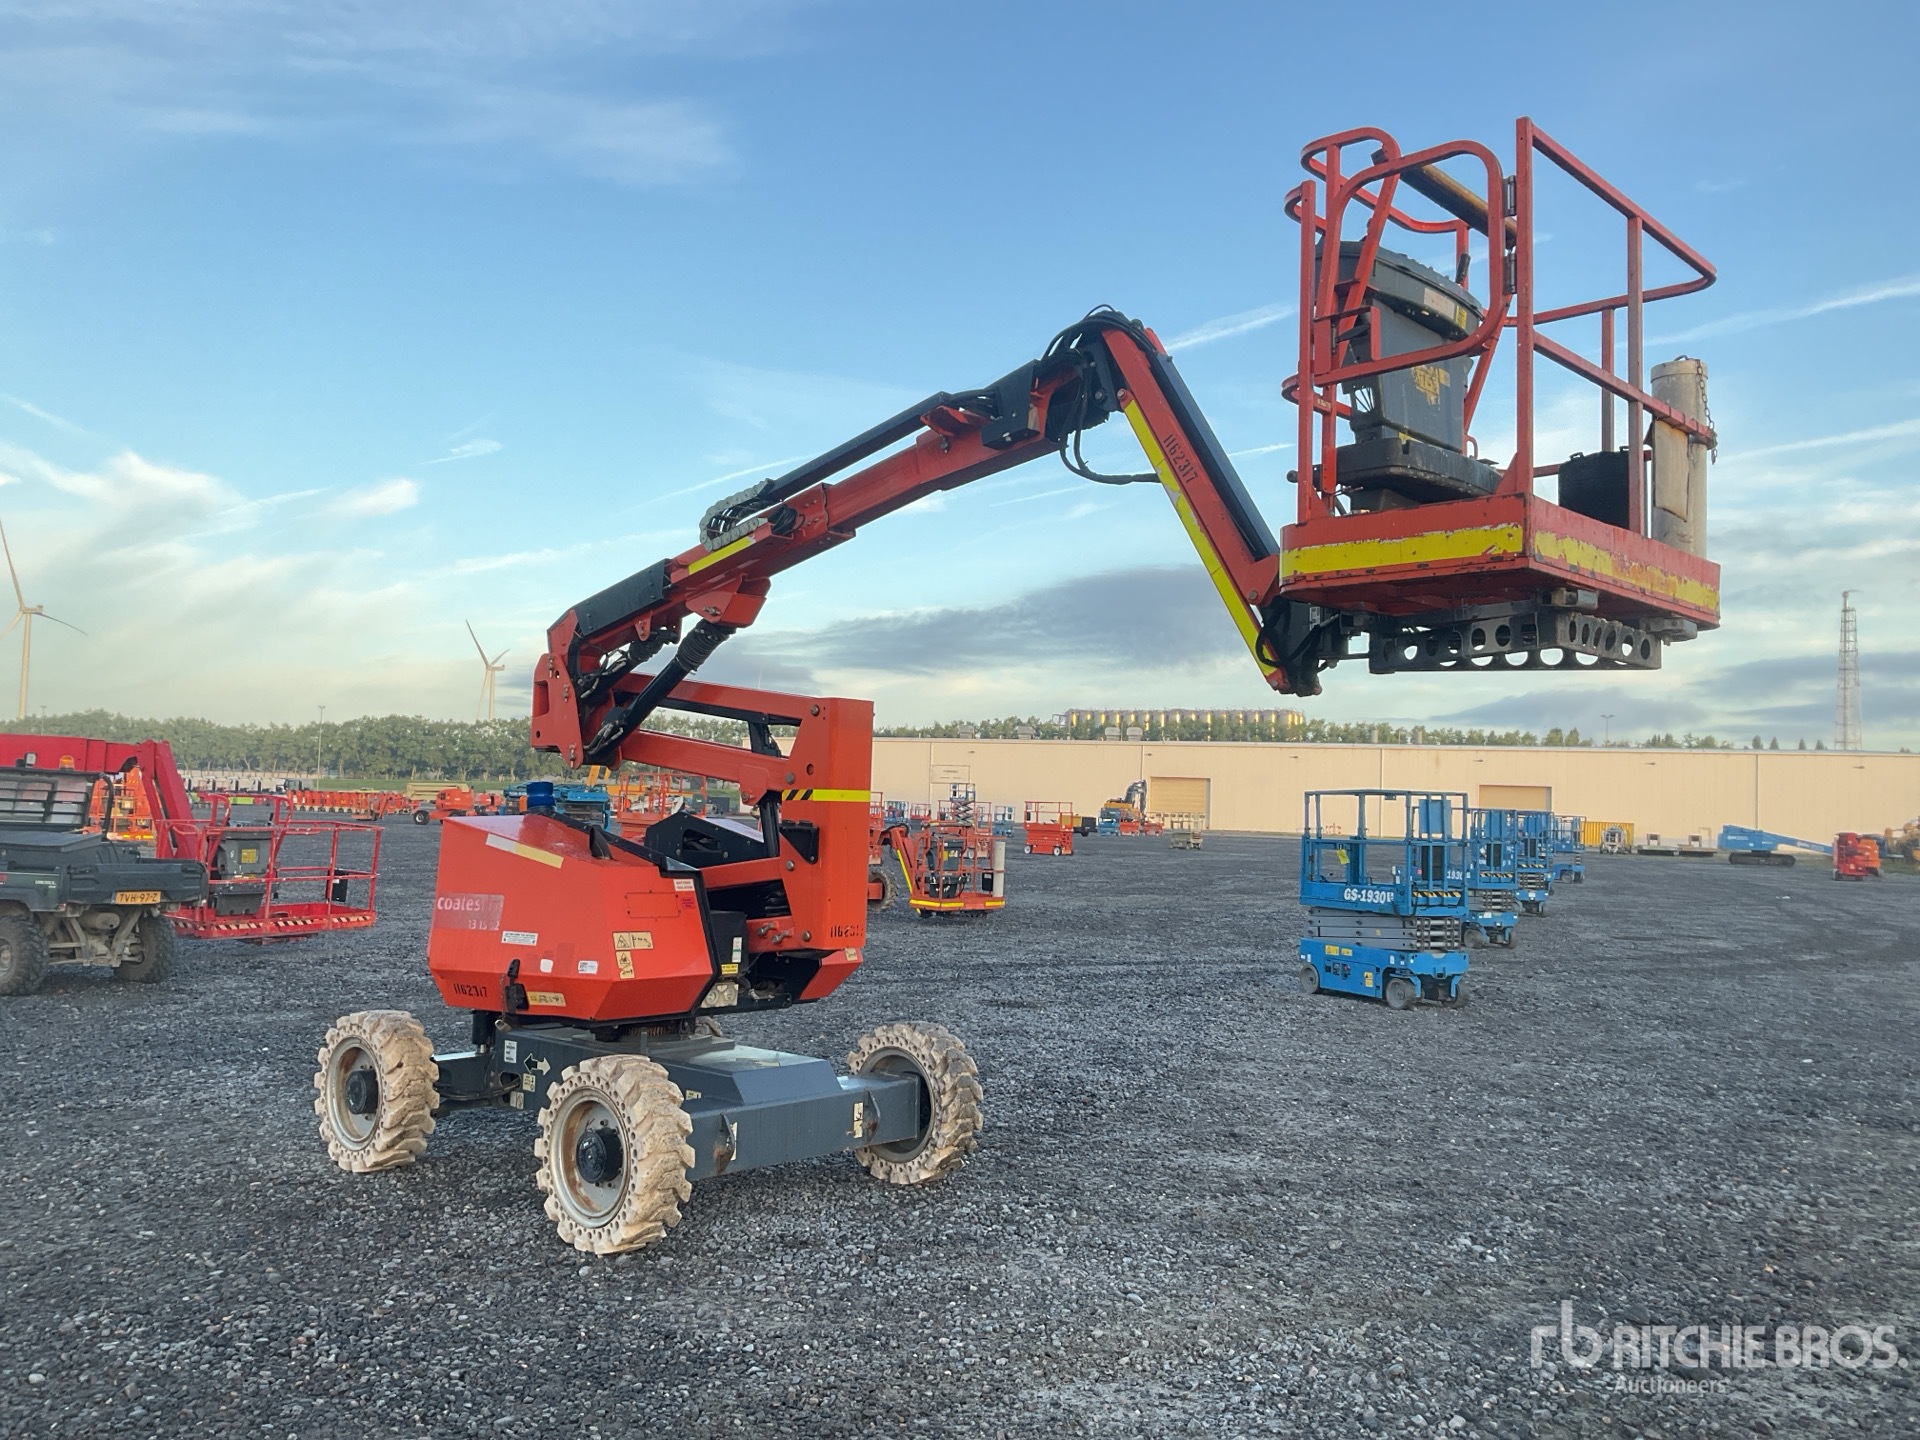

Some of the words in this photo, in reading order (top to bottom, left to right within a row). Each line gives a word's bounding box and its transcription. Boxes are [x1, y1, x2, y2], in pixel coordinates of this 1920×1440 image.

[1163, 434, 1199, 483] 1162317
[119, 892, 158, 902] TVH-97-Z
[453, 983, 488, 998] 1162317
